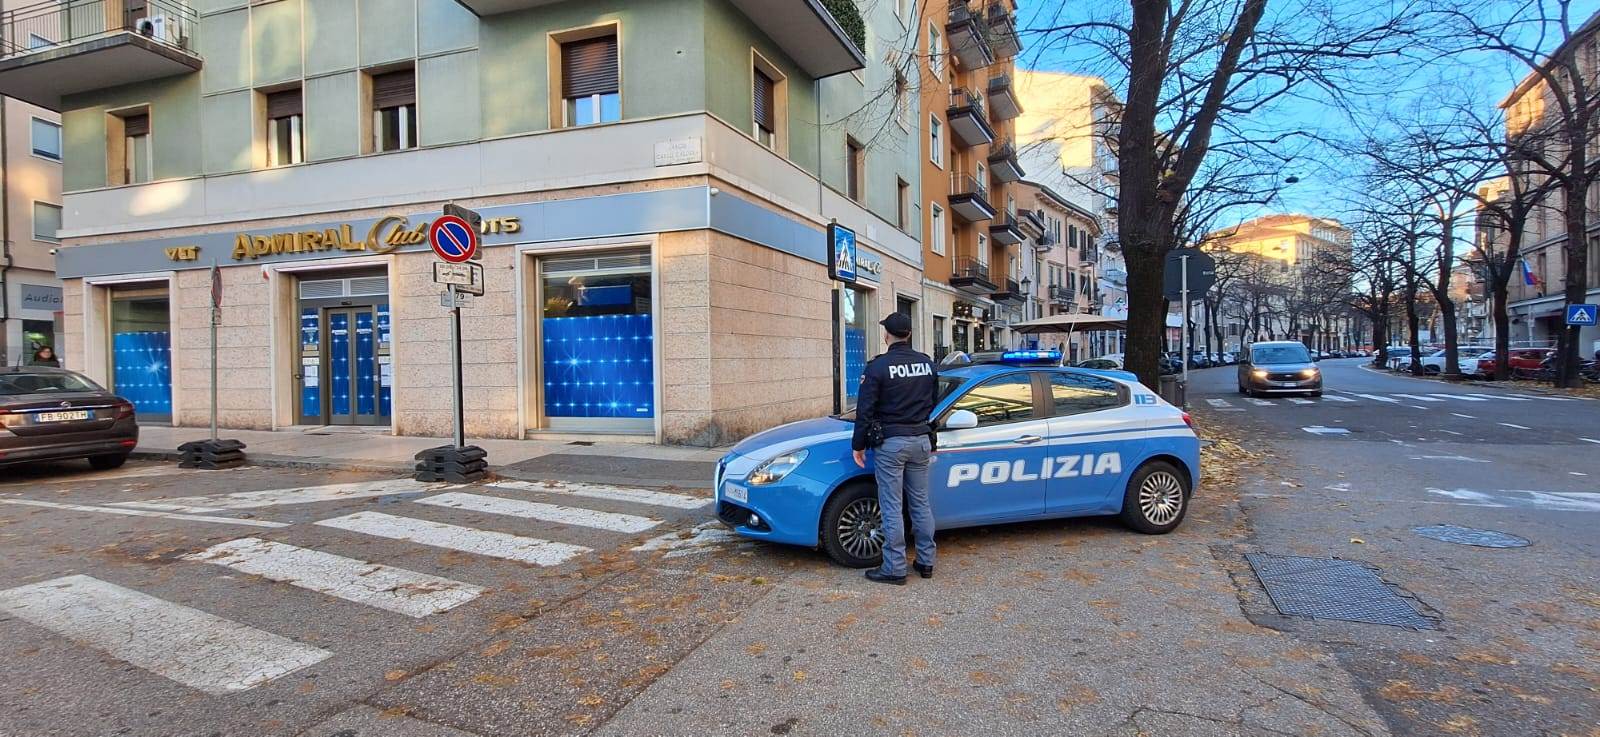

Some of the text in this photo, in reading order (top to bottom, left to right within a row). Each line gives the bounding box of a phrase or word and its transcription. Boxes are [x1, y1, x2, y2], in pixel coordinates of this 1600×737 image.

[232, 223, 366, 260] ADMIRAL
[367, 214, 428, 254] Club
[480, 216, 521, 234] OTS
[888, 362, 933, 379] POLIZIA
[1134, 394, 1157, 405] 113
[947, 452, 1122, 488] POLIZIA
